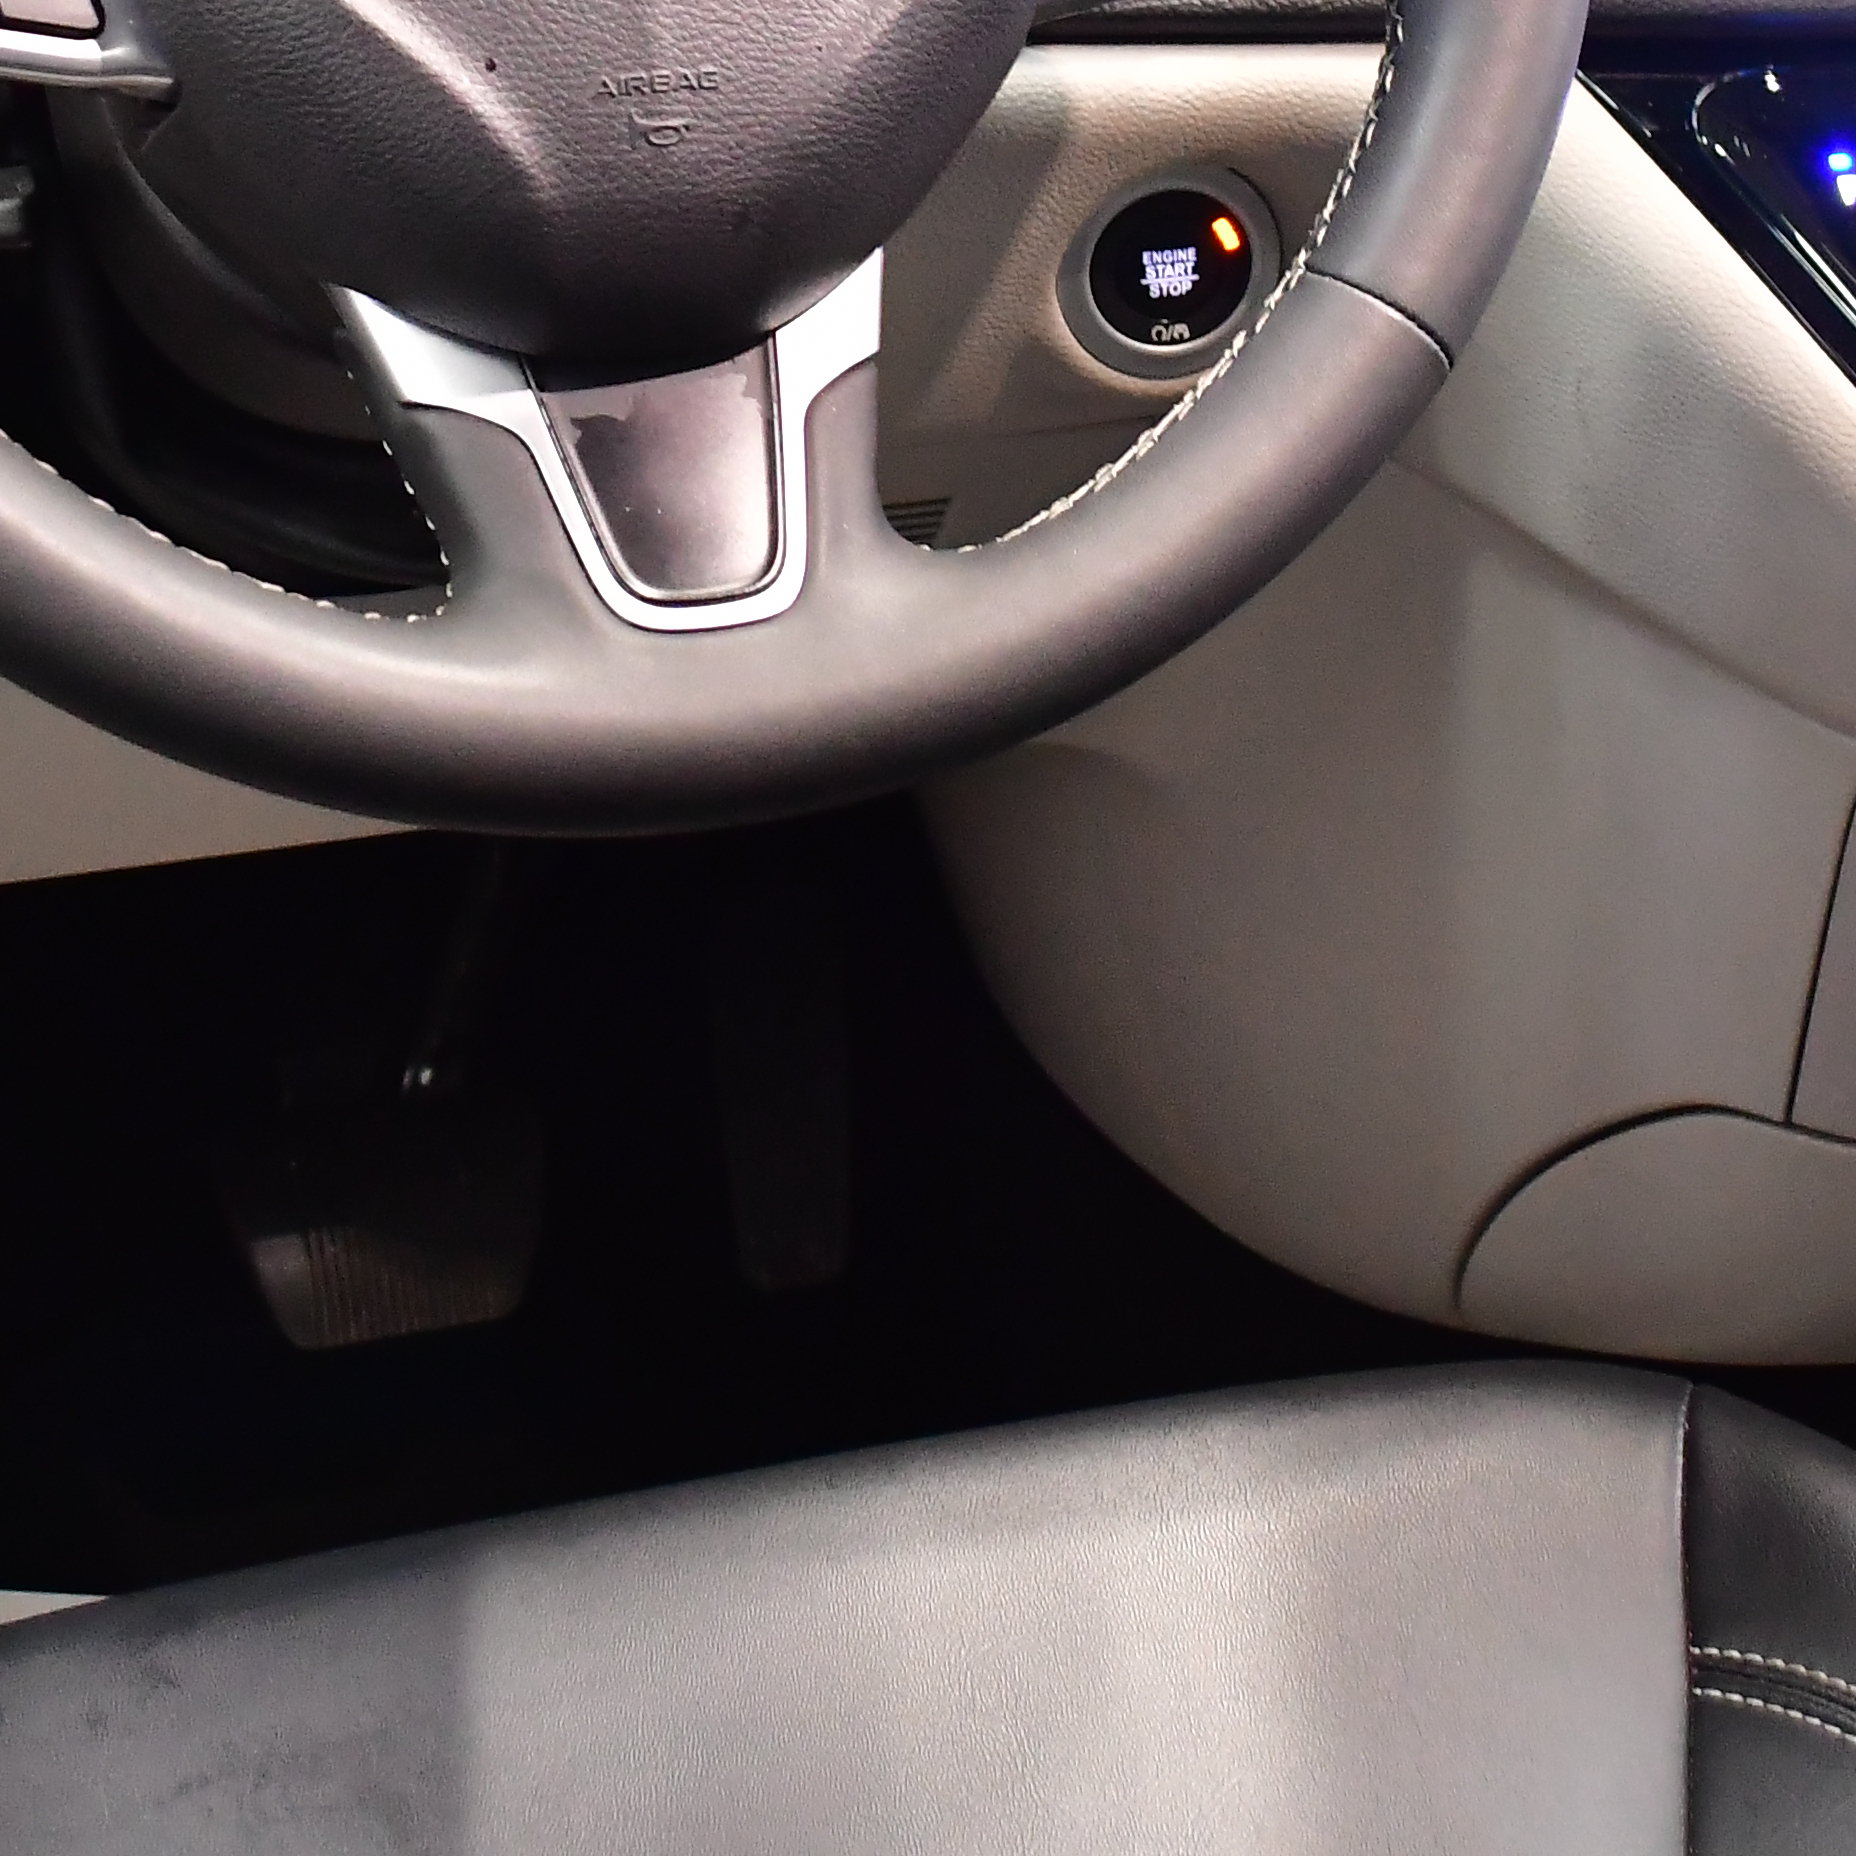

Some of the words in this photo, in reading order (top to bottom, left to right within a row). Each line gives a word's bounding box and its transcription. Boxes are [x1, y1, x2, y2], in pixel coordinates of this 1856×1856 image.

[1142, 247, 1197, 265] ENGINE
[1145, 262, 1194, 280] START
[1149, 280, 1192, 299] STOP
